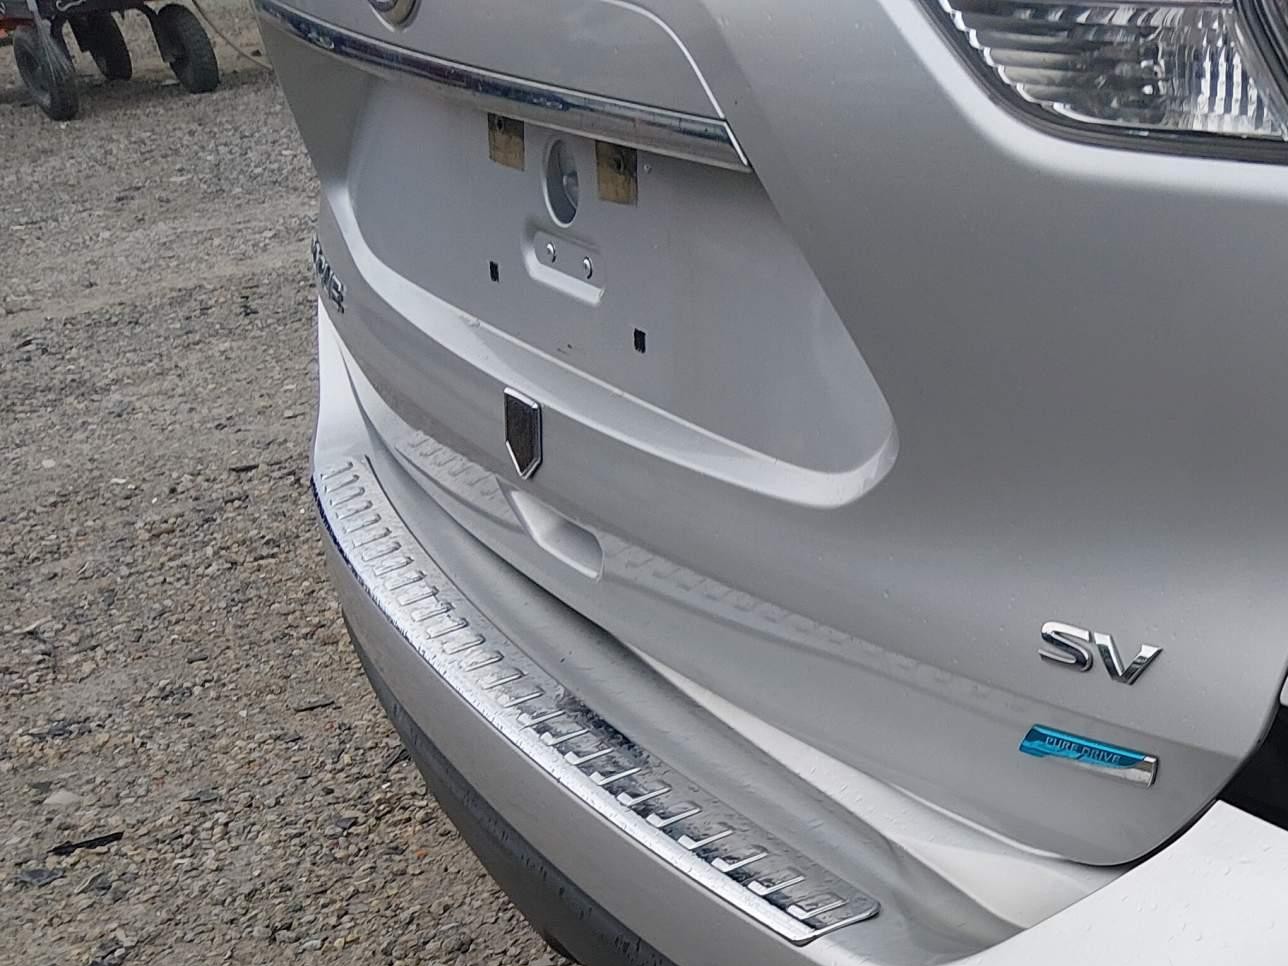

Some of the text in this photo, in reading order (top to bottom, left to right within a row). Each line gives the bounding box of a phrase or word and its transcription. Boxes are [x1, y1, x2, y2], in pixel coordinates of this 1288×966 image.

[1038, 621, 1163, 685] SV
[1045, 736, 1121, 763] PURE DRIVE
